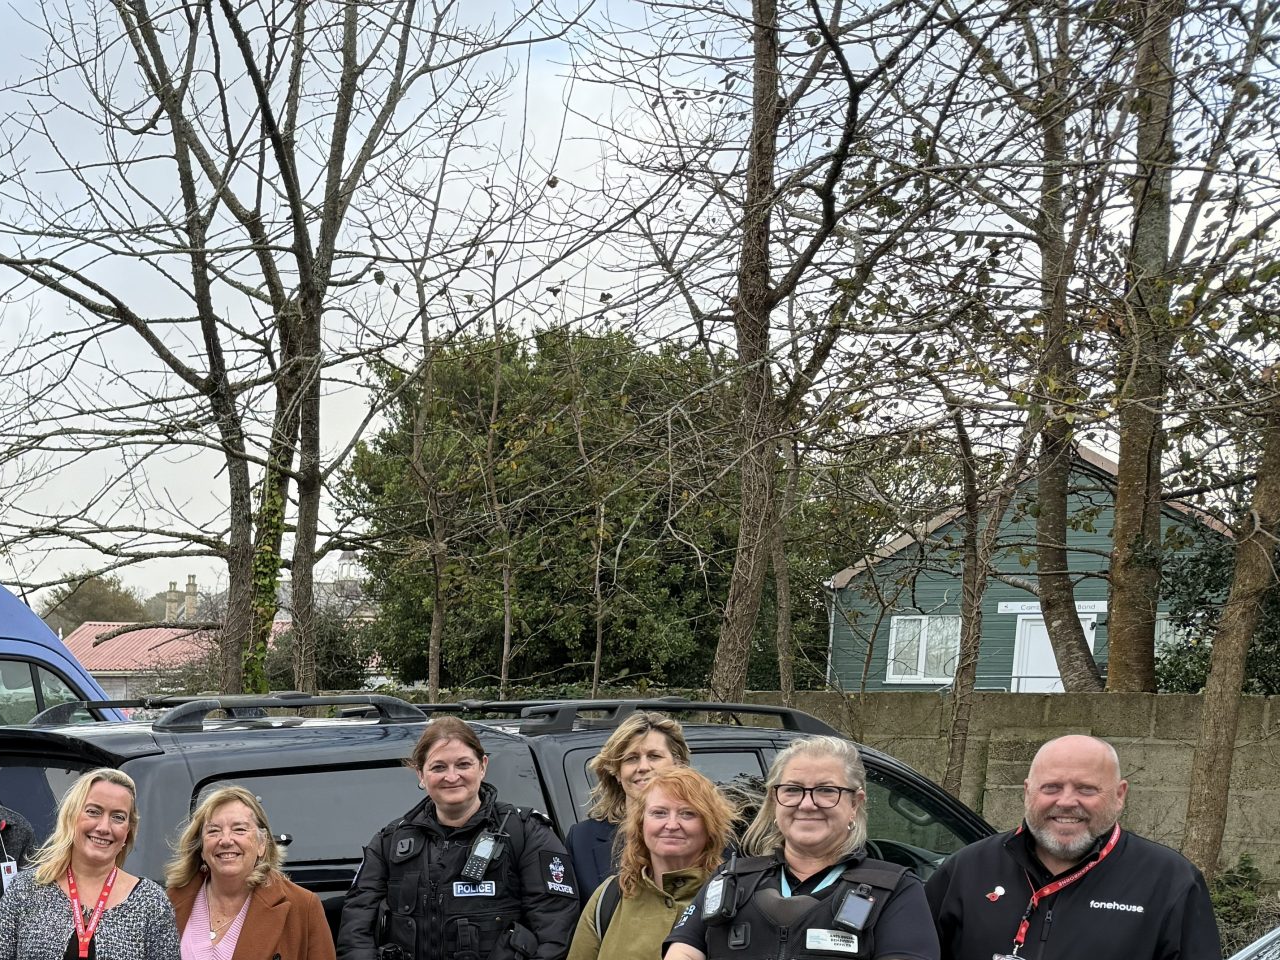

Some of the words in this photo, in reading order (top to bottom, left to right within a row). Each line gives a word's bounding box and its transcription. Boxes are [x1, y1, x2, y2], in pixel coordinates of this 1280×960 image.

[457, 884, 492, 893] POLICE
[547, 882, 575, 895] POLICE
[1090, 900, 1144, 913] fonehouse
